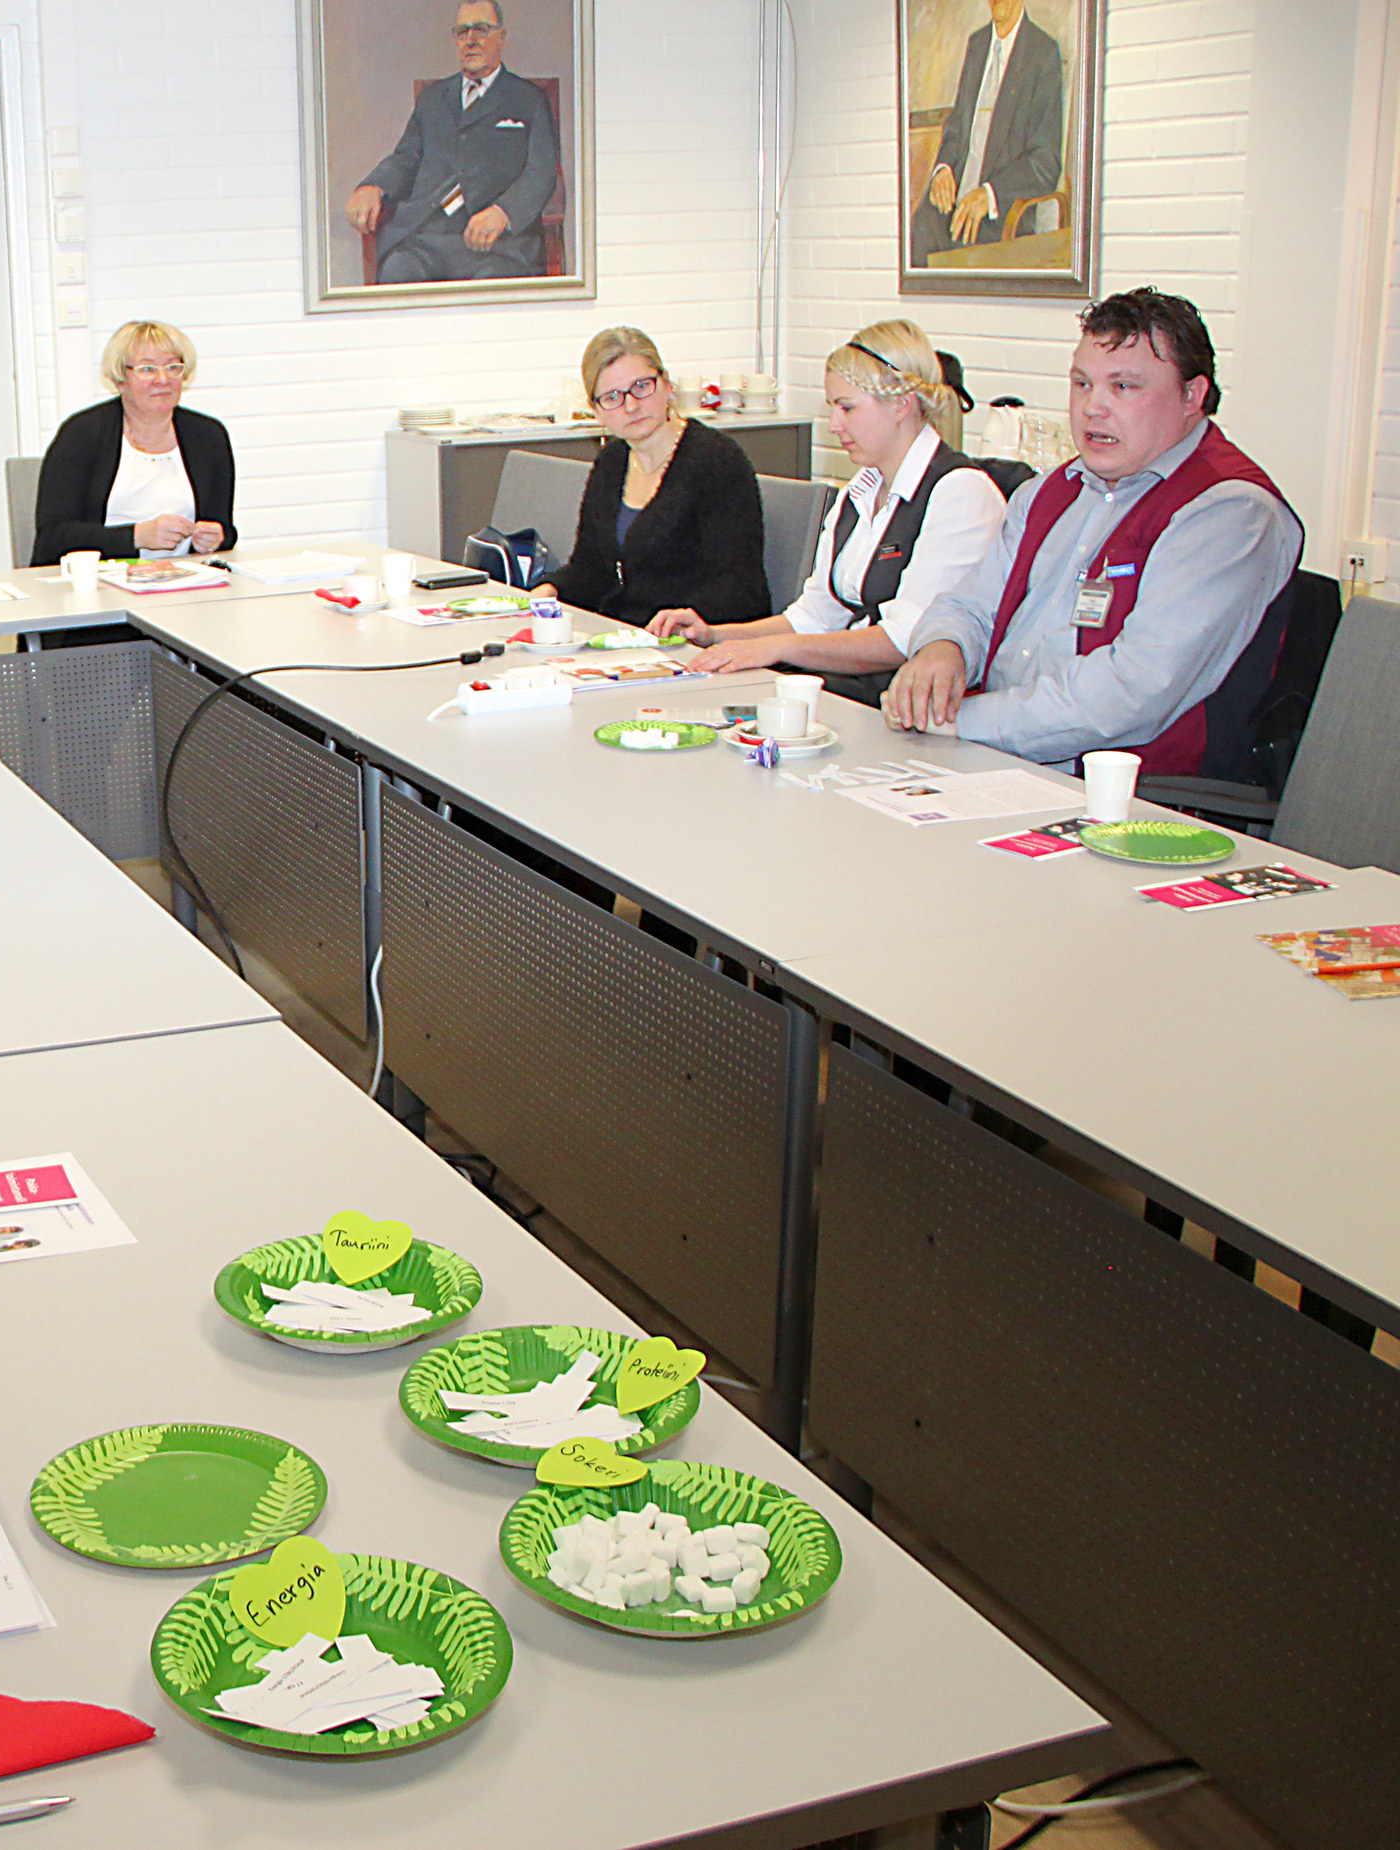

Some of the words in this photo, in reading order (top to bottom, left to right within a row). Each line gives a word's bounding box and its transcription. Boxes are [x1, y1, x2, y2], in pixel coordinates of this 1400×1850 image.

[329, 1229, 390, 1250] Tauriini
[560, 1443, 629, 1479] Sokeri
[246, 1563, 326, 1627] Energia
